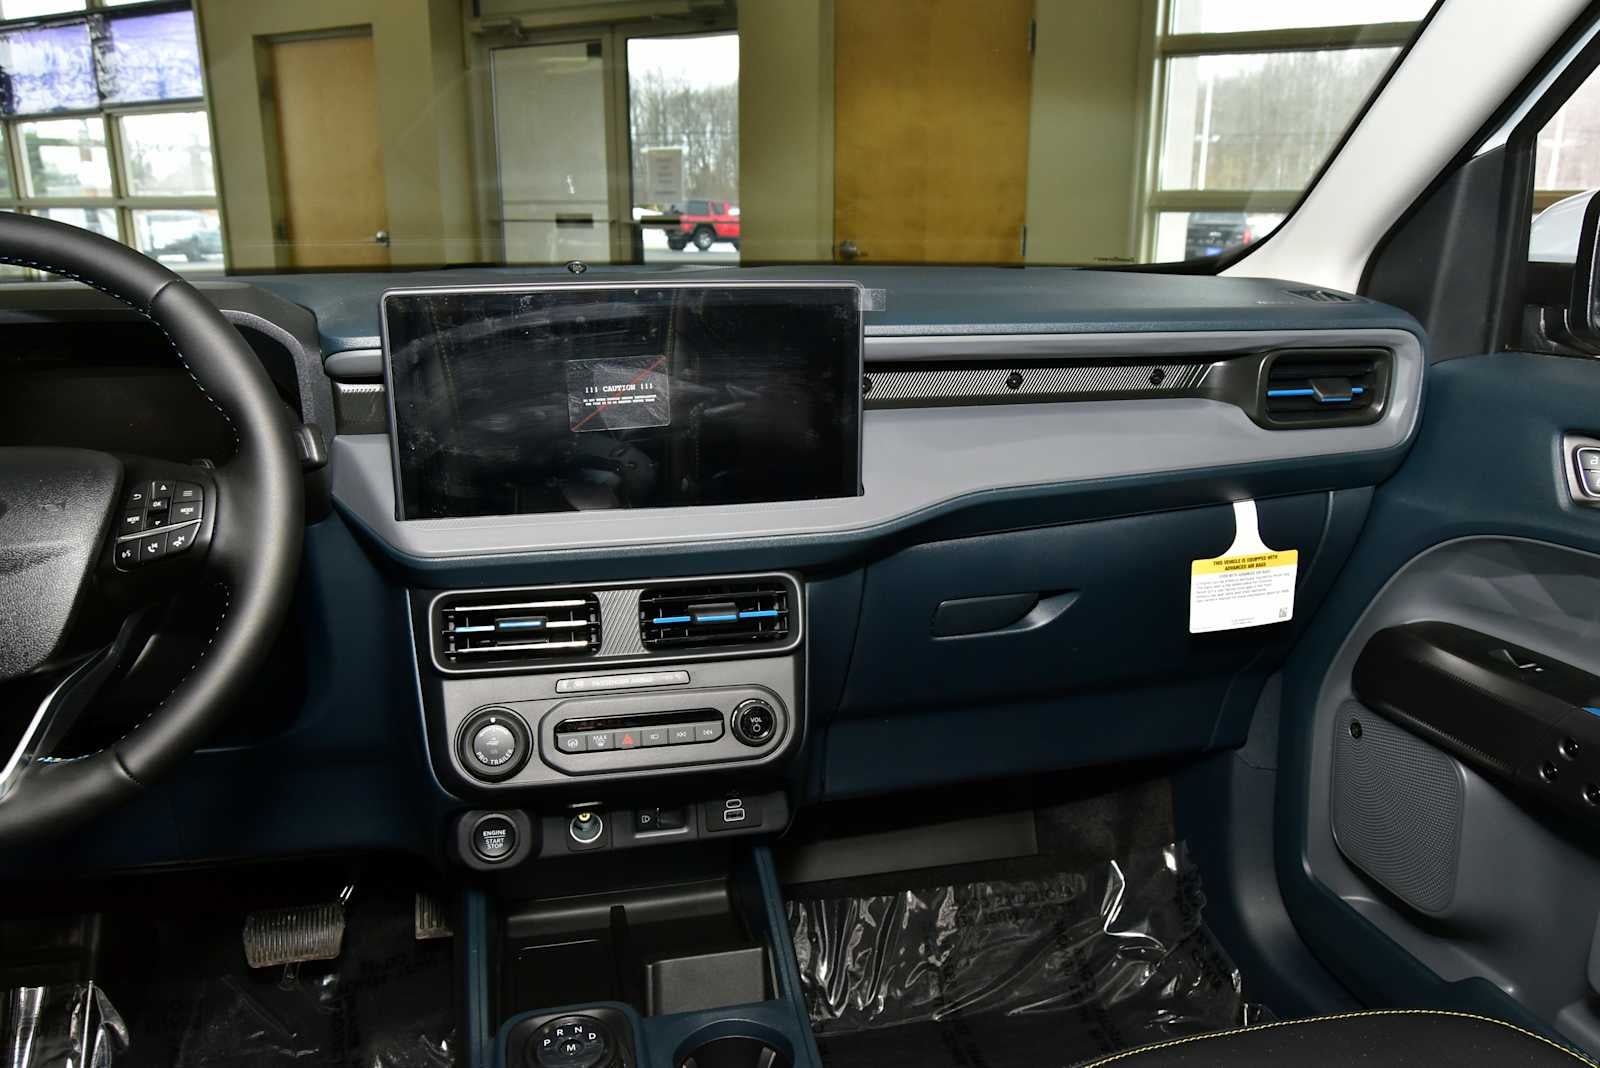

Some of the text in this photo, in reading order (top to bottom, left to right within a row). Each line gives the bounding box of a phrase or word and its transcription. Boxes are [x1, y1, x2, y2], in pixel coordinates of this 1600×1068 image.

[602, 384, 636, 392] CAUTION
[1246, 555, 1266, 563] EQUIPPED
[476, 749, 513, 765] PRO TRAILER
[483, 829, 507, 837] ENGINE
[485, 837, 505, 845] START
[543, 1038, 551, 1047] P
[556, 1028, 564, 1037] R
[588, 1032, 597, 1040] D
[566, 1043, 576, 1052] M
